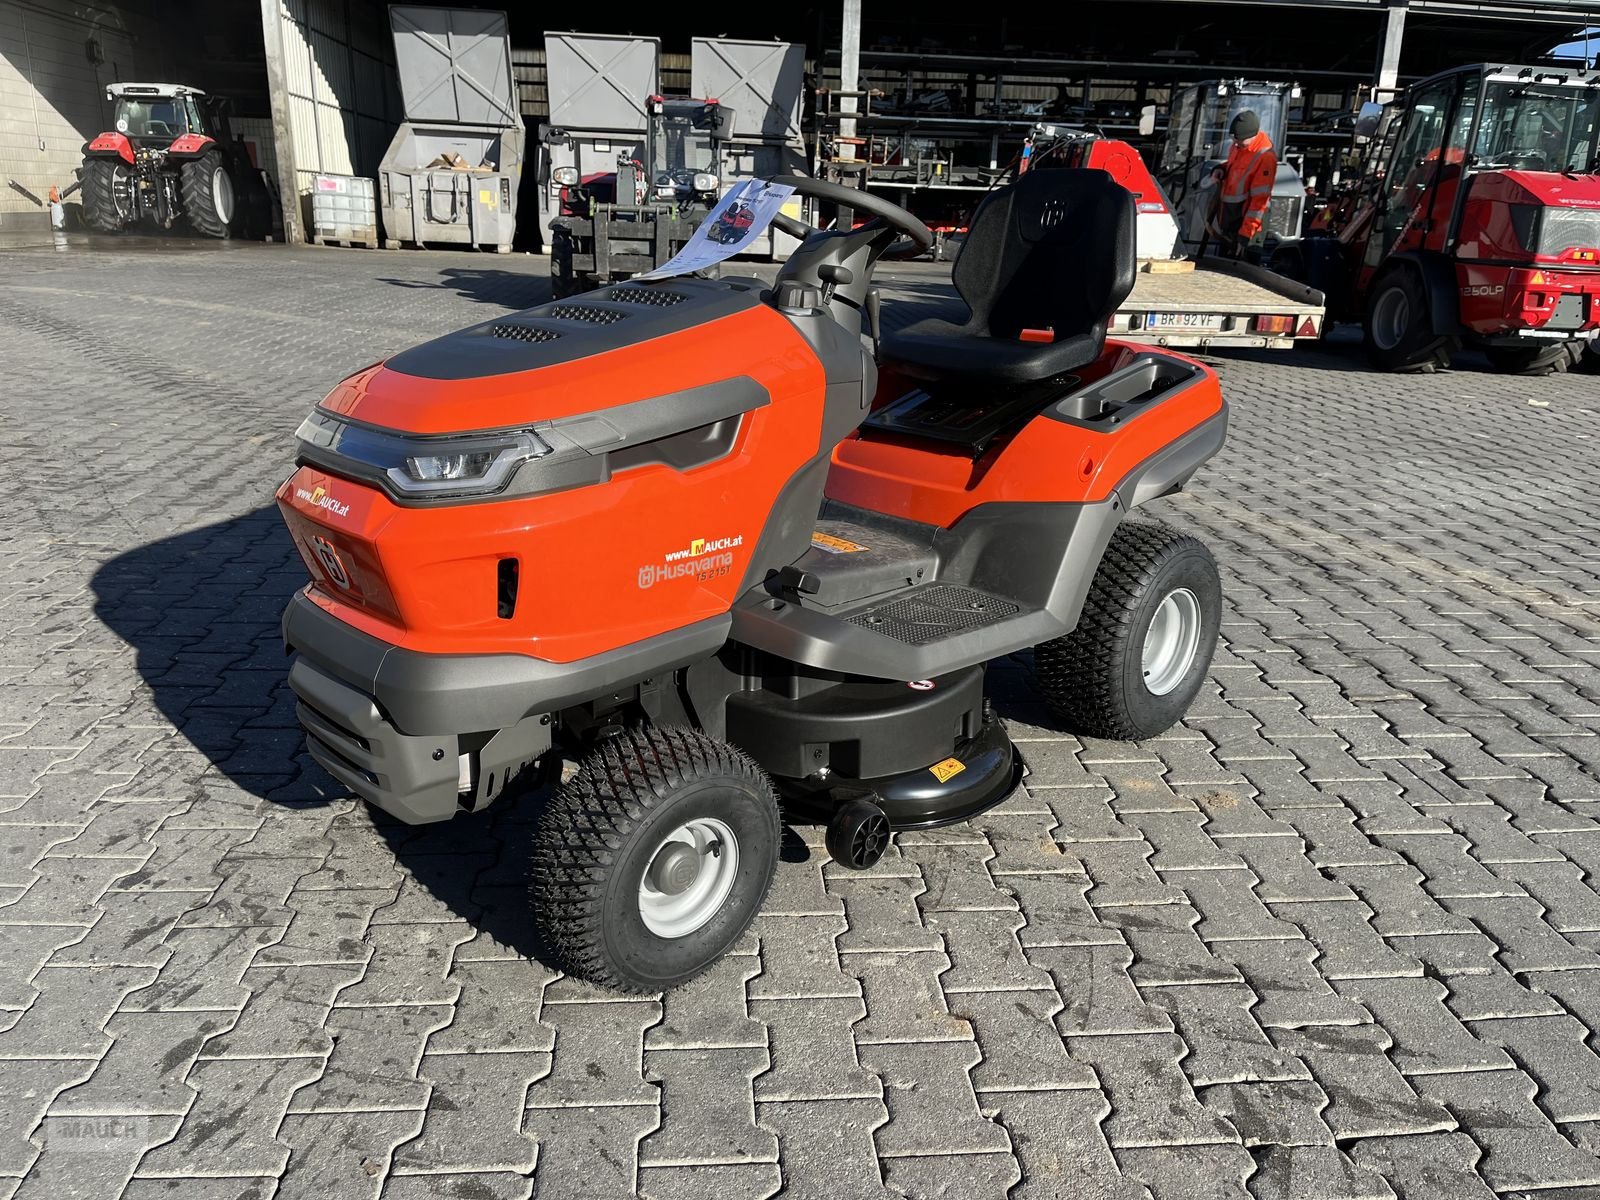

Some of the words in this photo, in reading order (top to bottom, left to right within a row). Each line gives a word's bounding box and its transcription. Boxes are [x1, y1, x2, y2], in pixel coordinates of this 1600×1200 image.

[1161, 313, 1175, 325] BR
[1184, 314, 1197, 326] 92
[1201, 314, 1213, 326] VF
[296, 487, 350, 517] www.MAUCH.at
[665, 535, 742, 562] www.MAUCH.at
[656, 552, 732, 581] Husqvarna
[696, 572, 707, 582] TS
[708, 565, 731, 579] 215T
